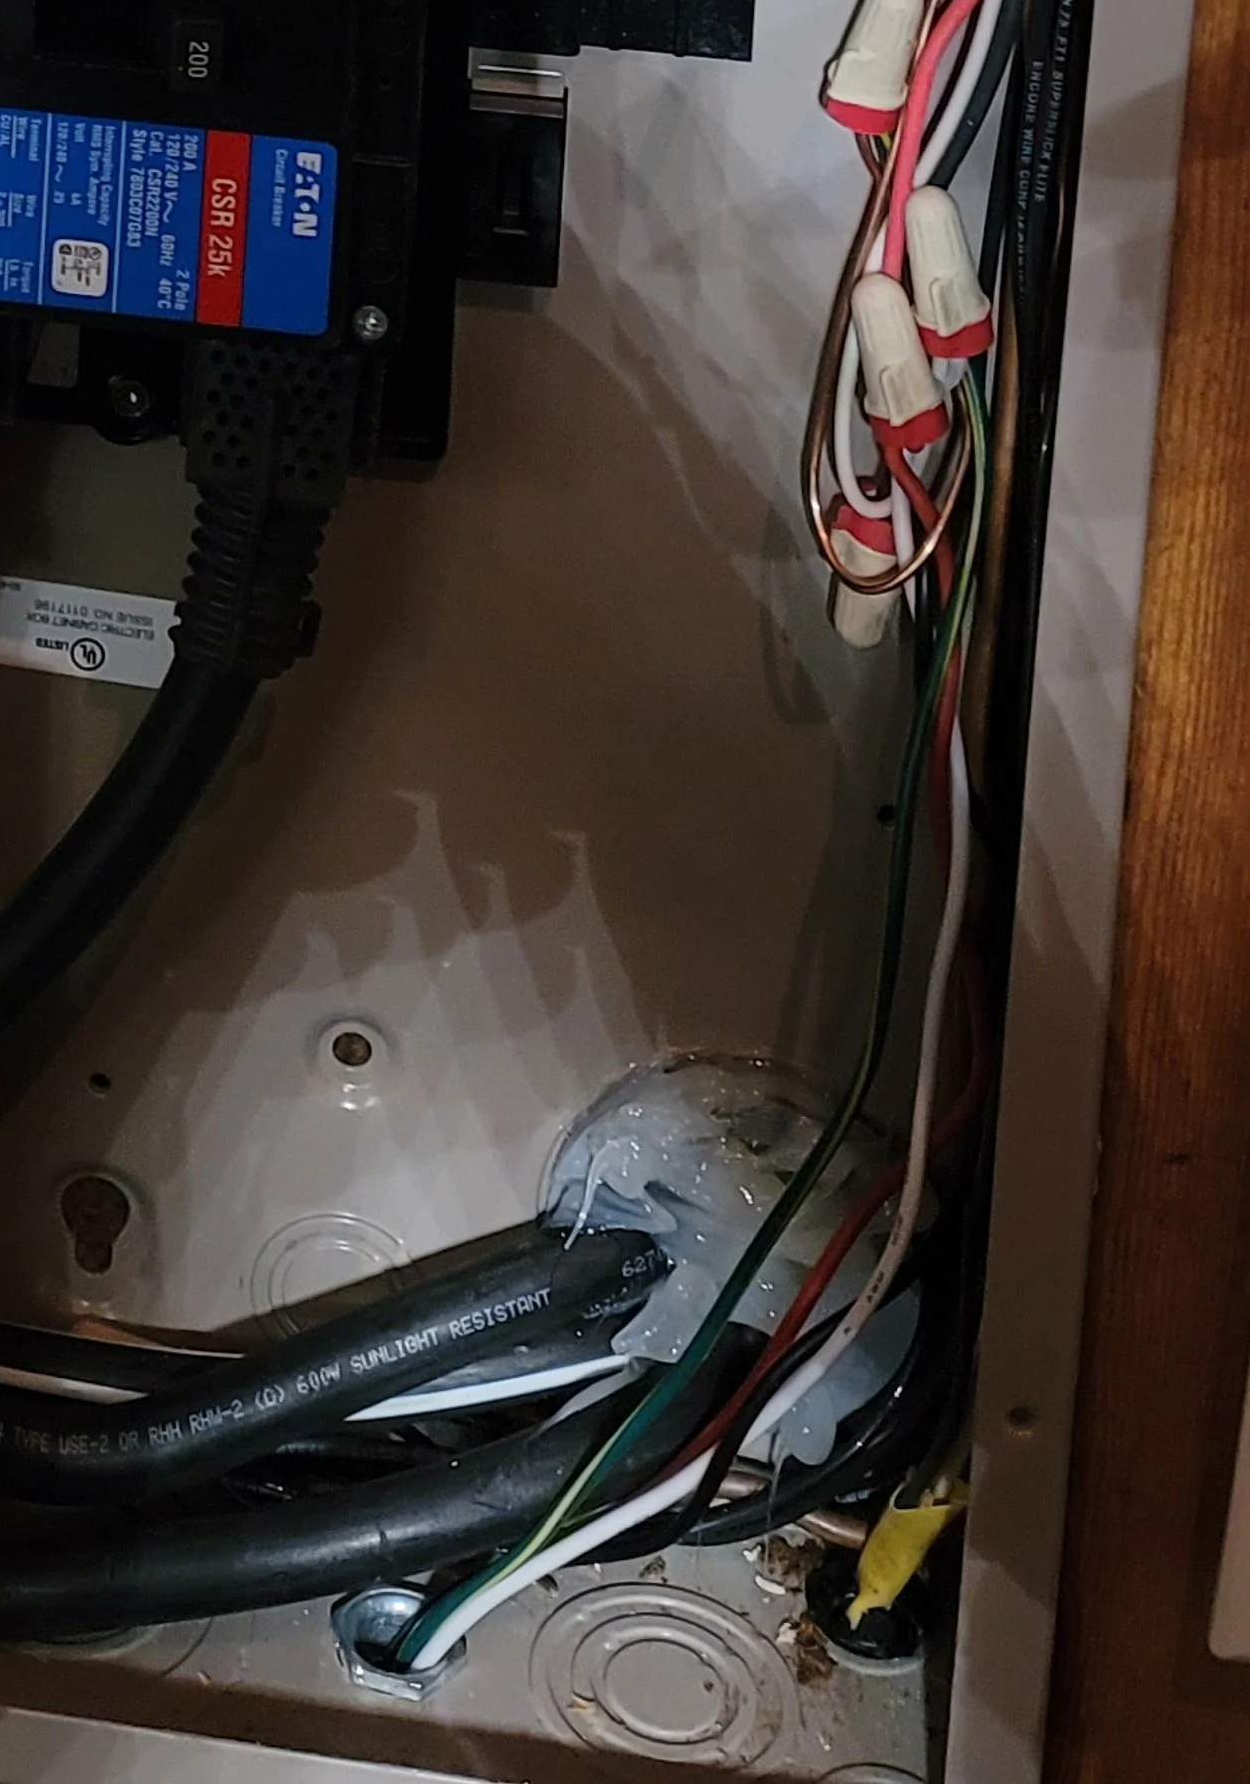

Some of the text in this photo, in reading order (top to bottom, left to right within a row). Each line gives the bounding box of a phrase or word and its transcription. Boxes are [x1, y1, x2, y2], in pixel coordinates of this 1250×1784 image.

[187, 40, 210, 79] 200
[130, 129, 147, 162] Style
[149, 132, 165, 156] Cat.
[164, 134, 181, 189] 120/240
[182, 134, 198, 172] 200 A
[271, 149, 289, 228] Circuit Breaker
[293, 151, 322, 237] EATON
[207, 178, 237, 277] CSR 25k
[160, 234, 176, 266] 60Hz
[174, 268, 190, 311] 2 Pole
[103, 623, 155, 641] ELECTRIC
[58, 1433, 110, 1456] USE-2
[350, 1326, 440, 1375] SUNLIGHT
[449, 1287, 552, 1342] RESISTANT
